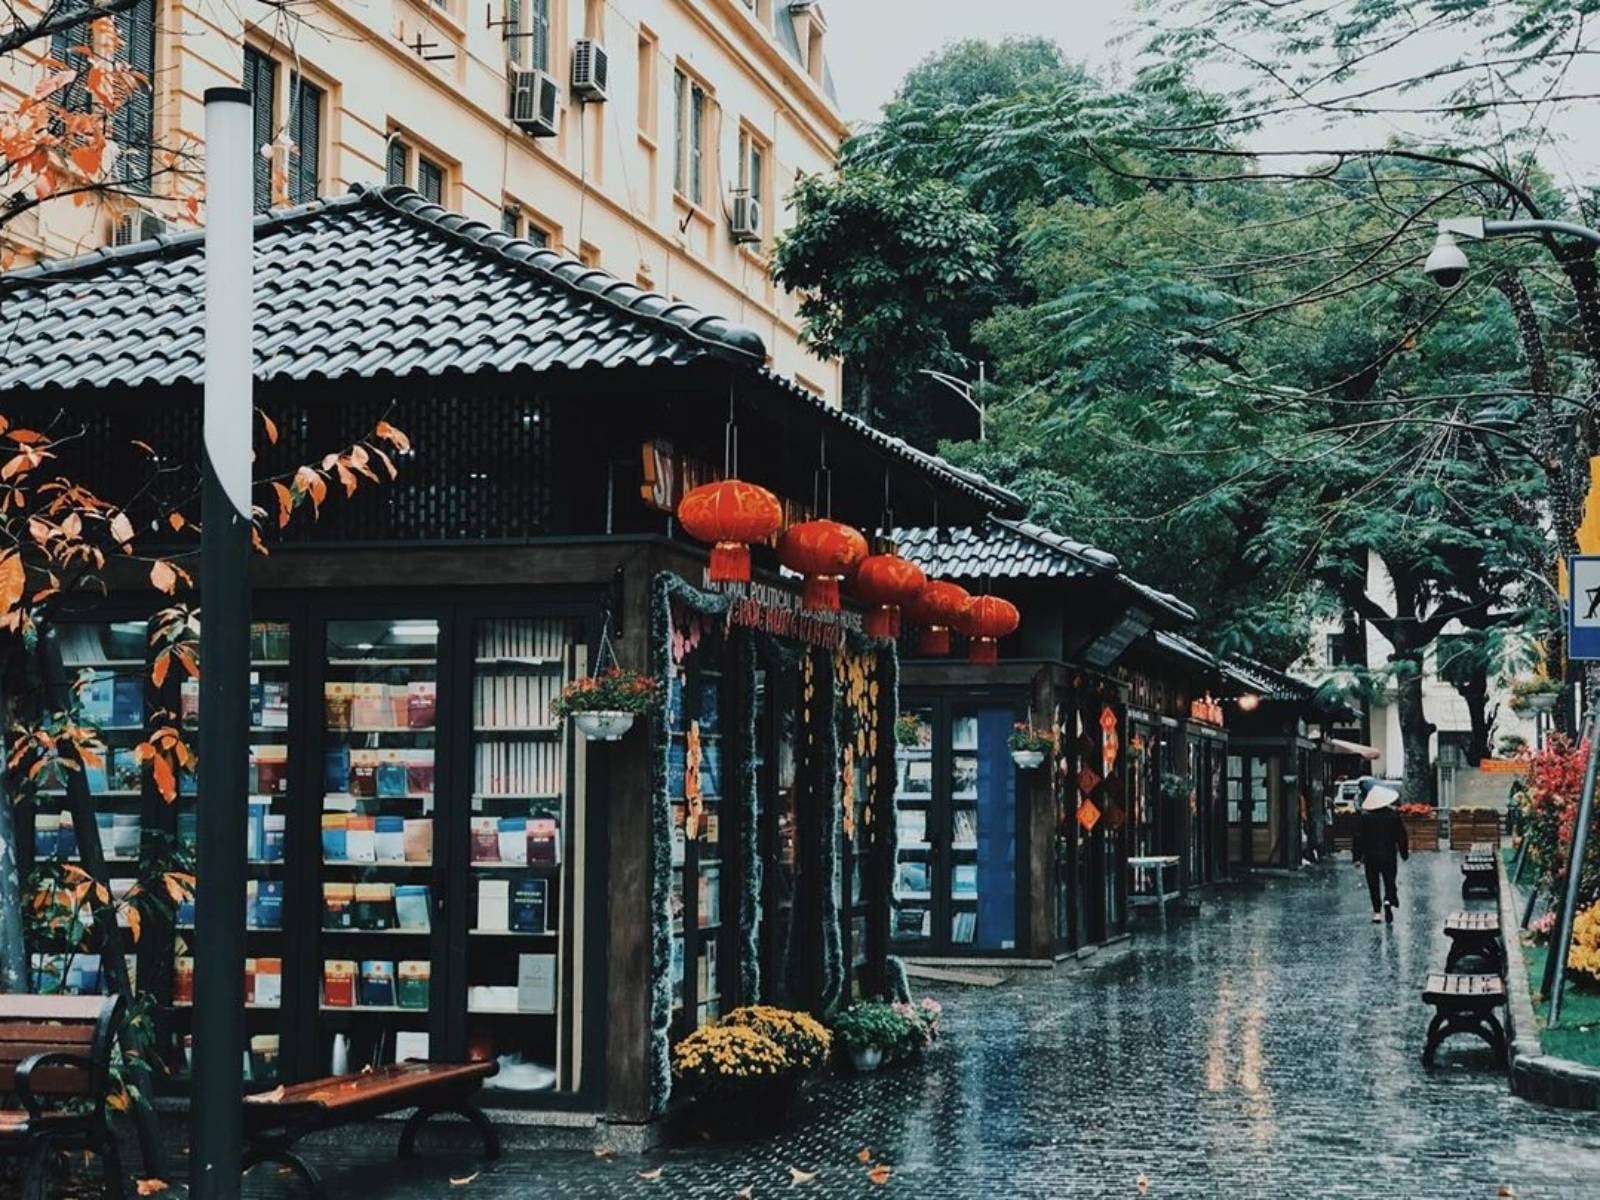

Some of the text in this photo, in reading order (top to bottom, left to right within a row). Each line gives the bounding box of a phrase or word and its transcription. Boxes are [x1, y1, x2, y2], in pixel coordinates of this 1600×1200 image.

[703, 567, 747, 598] NATONAL
[751, 581, 792, 611] POLITICAL
[841, 609, 863, 633] HOUSE
